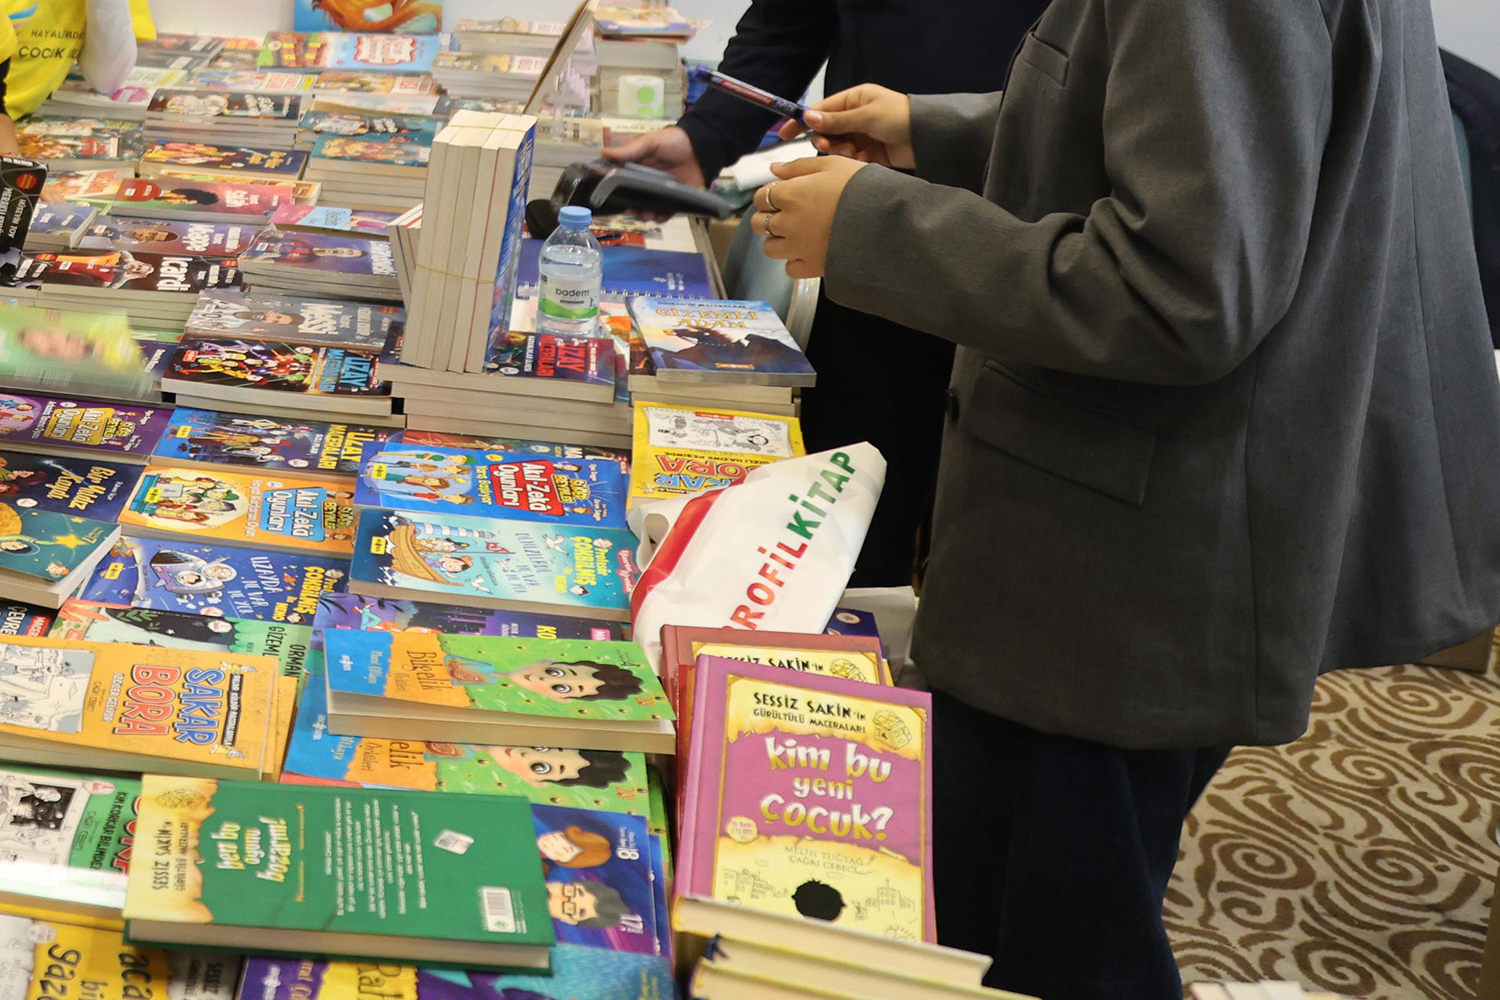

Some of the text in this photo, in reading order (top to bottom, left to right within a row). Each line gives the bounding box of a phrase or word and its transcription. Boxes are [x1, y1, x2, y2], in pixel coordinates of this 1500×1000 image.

[156, 256, 194, 292] Icardi
[555, 286, 591, 299] badem
[296, 303, 344, 335] Messi
[671, 317, 749, 329] ADAM
[338, 356, 372, 387] UZAY
[316, 424, 349, 470] MACERALARI
[340, 431, 376, 462] UZAY
[655, 455, 758, 478] ORA
[68, 466, 117, 511] Bir Yıldız
[493, 464, 522, 506] Oyunları
[521, 463, 551, 512] Akıl-Zekâ
[265, 490, 295, 532] Oyunları
[290, 489, 320, 537] Akıl-Zekâ
[729, 451, 856, 632] ROFİLKİTAP
[569, 535, 597, 587] ÇOKBİLMİŞ
[299, 566, 325, 615] ÇOKBİLMİŞ
[272, 602, 291, 621] MEMO
[262, 626, 284, 657] GİZEML
[405, 650, 453, 691] Bilgelik
[112, 664, 181, 736] BORA
[174, 665, 226, 746] SAKAR
[753, 691, 798, 712] SESSİZ
[752, 707, 867, 735] GÜRÜLTÜLÜ MACERALARI
[764, 735, 893, 786] kim bu
[112, 791, 129, 804] KİM
[792, 775, 854, 802] yeni
[101, 804, 123, 835] KORKAR
[153, 860, 169, 891] SESSİZ
